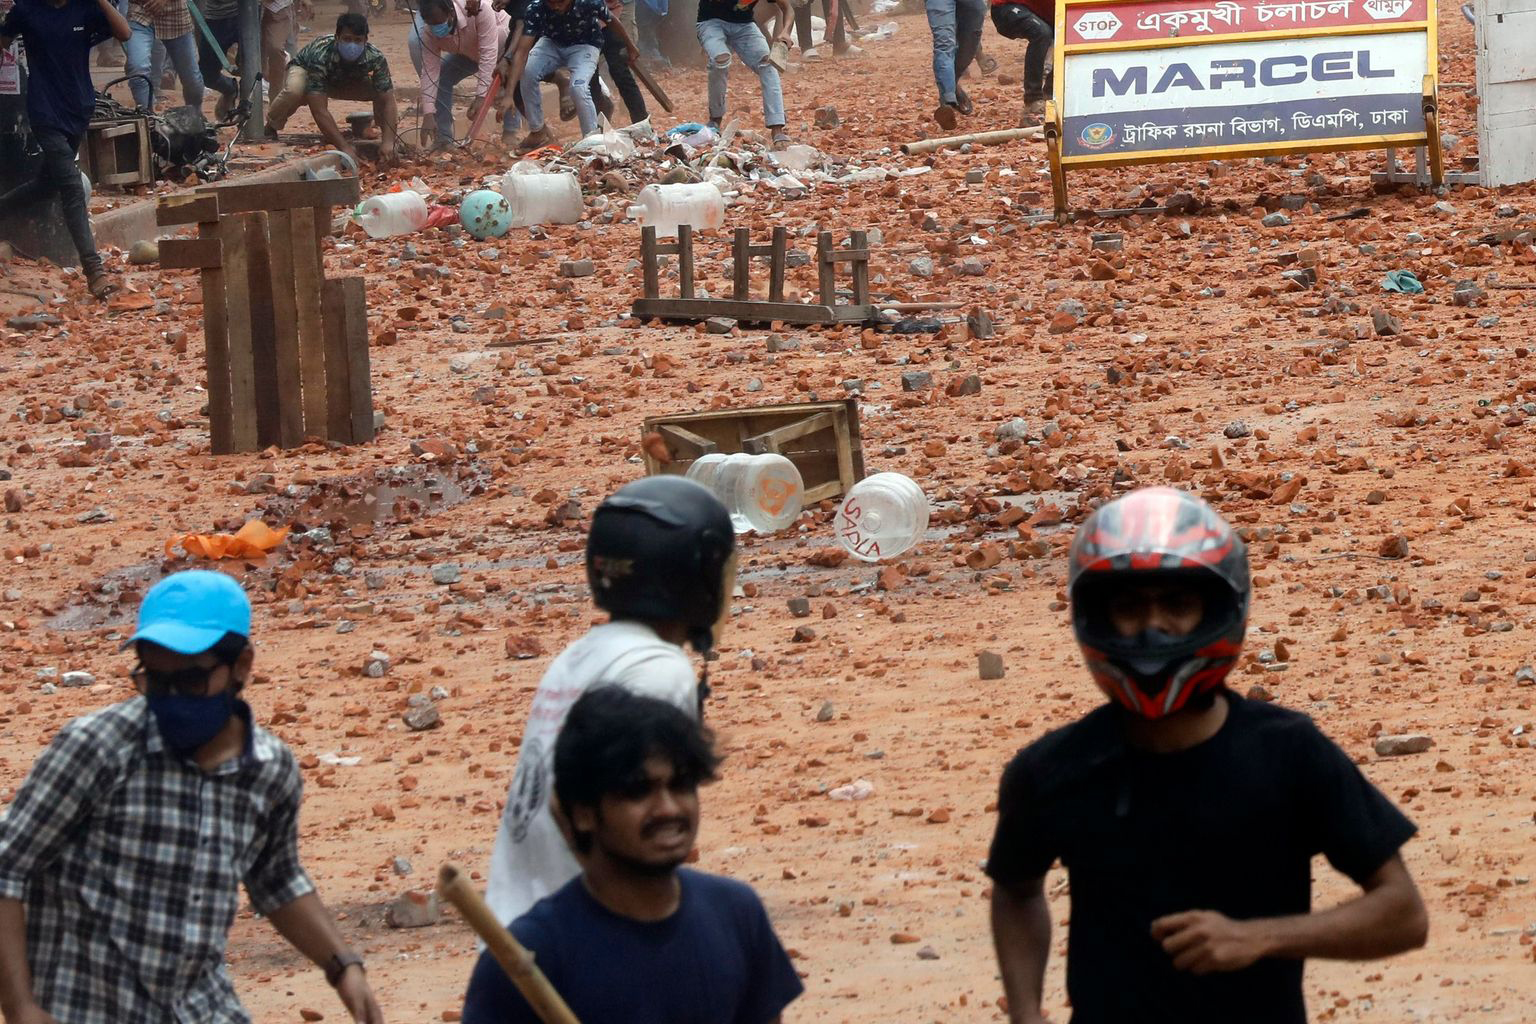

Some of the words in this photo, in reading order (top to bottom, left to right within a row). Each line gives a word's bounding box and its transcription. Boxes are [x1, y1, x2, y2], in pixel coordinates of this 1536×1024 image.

[1078, 19, 1118, 32] STOP
[1137, 1, 1247, 33] একমুখী
[1092, 50, 1395, 98] MARCEL
[1121, 123, 1177, 146] ট্রাফিক
[1183, 123, 1224, 139] রমনা
[1230, 117, 1285, 137] বিভাগ,
[1291, 109, 1363, 131] ডিএমপি,
[1371, 106, 1409, 126] ঢাকা
